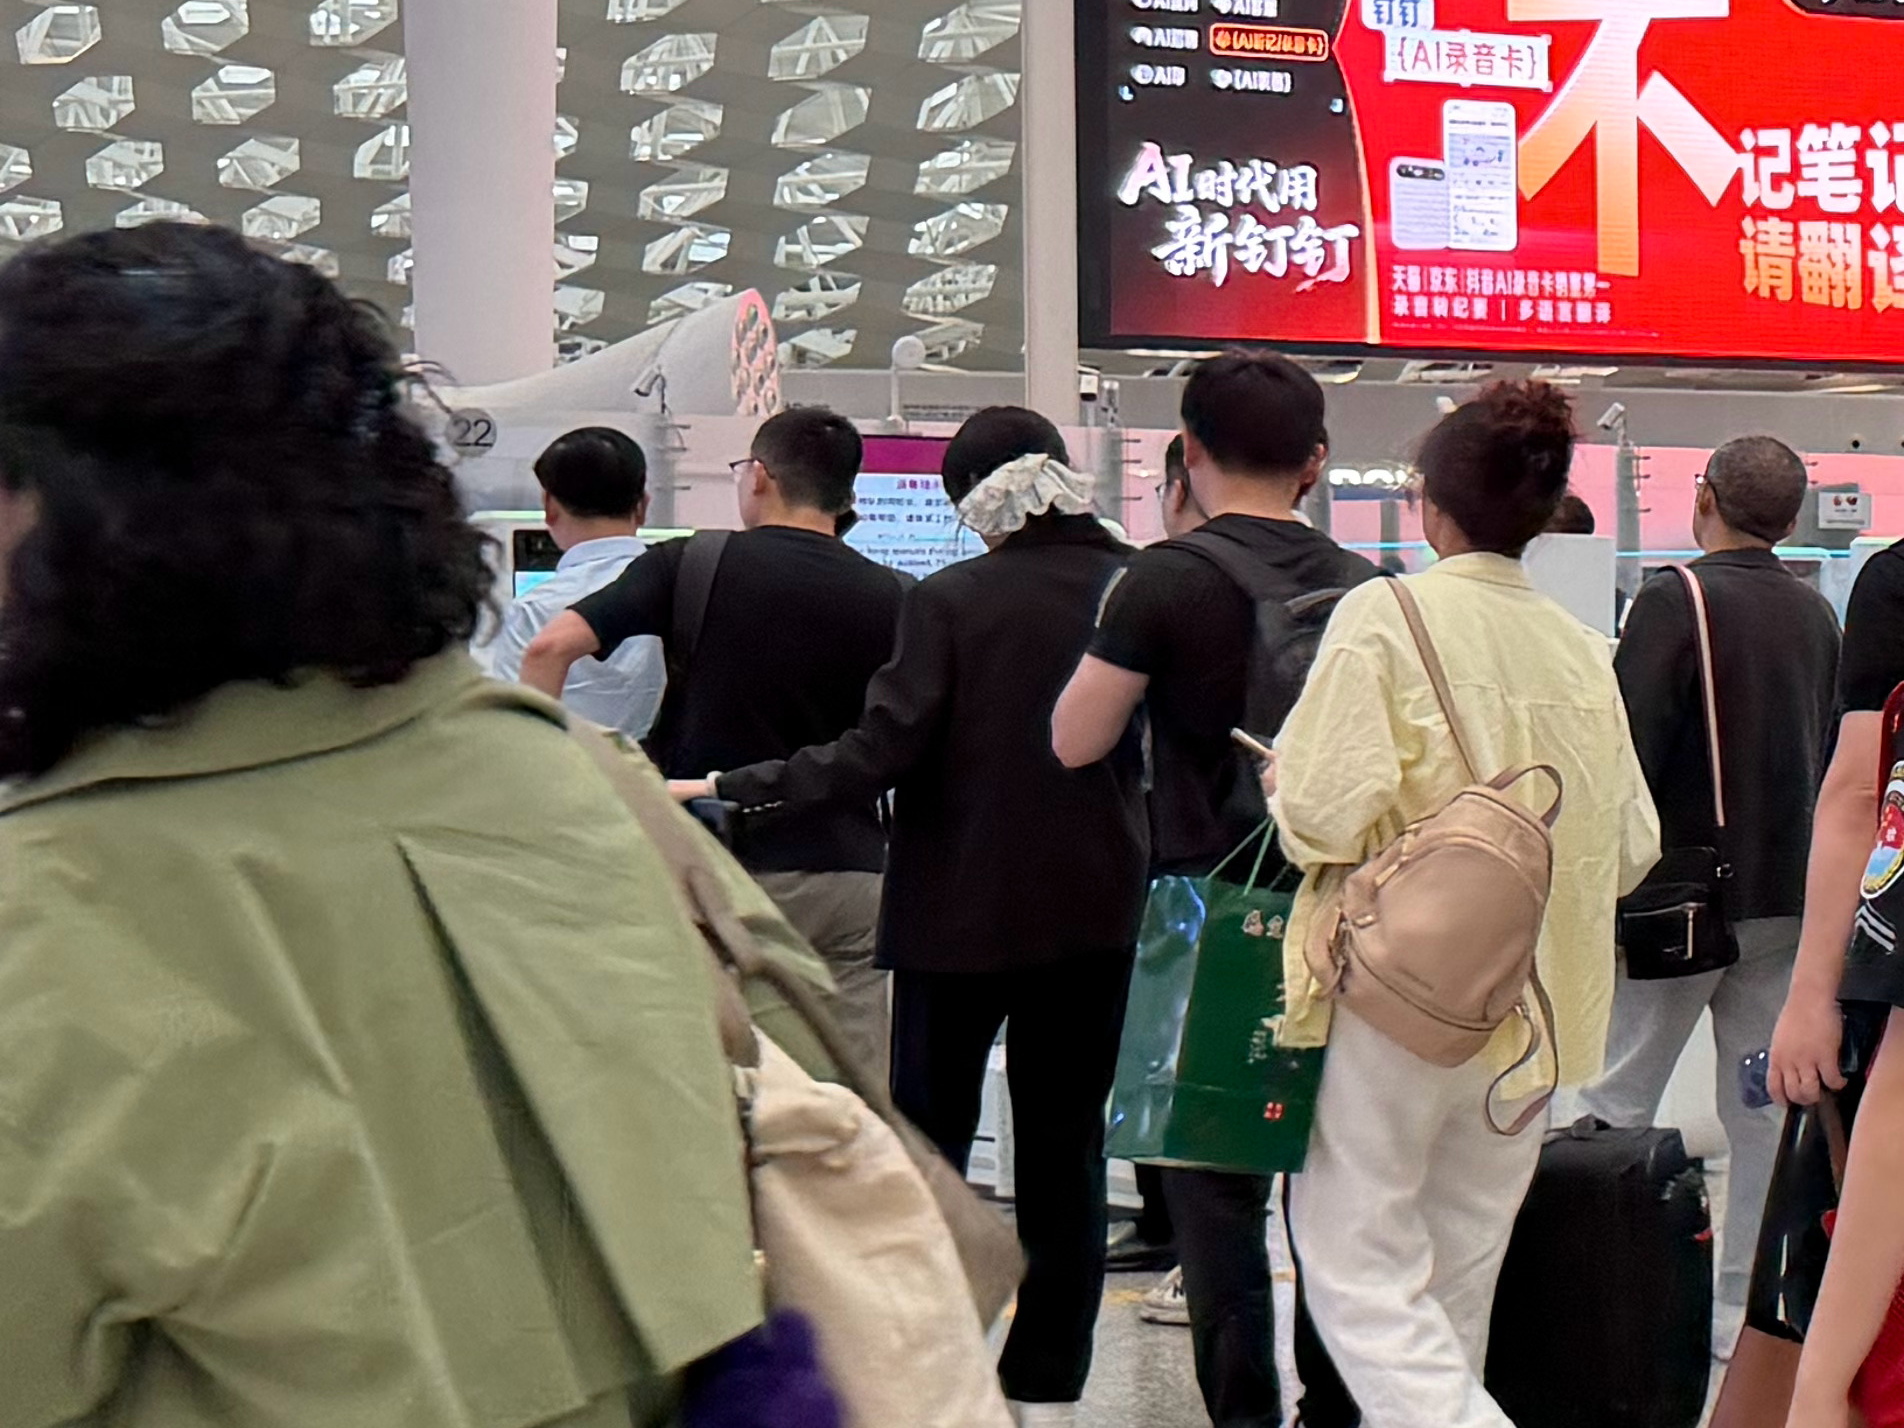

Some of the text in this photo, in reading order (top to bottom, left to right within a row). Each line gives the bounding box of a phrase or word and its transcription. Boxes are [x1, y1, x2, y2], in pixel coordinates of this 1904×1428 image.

[1397, 36, 1537, 81] {AI录音卡}
[1117, 141, 1319, 213] AI时代用
[1151, 203, 1361, 293] 新钉钉
[453, 417, 495, 448] 22
